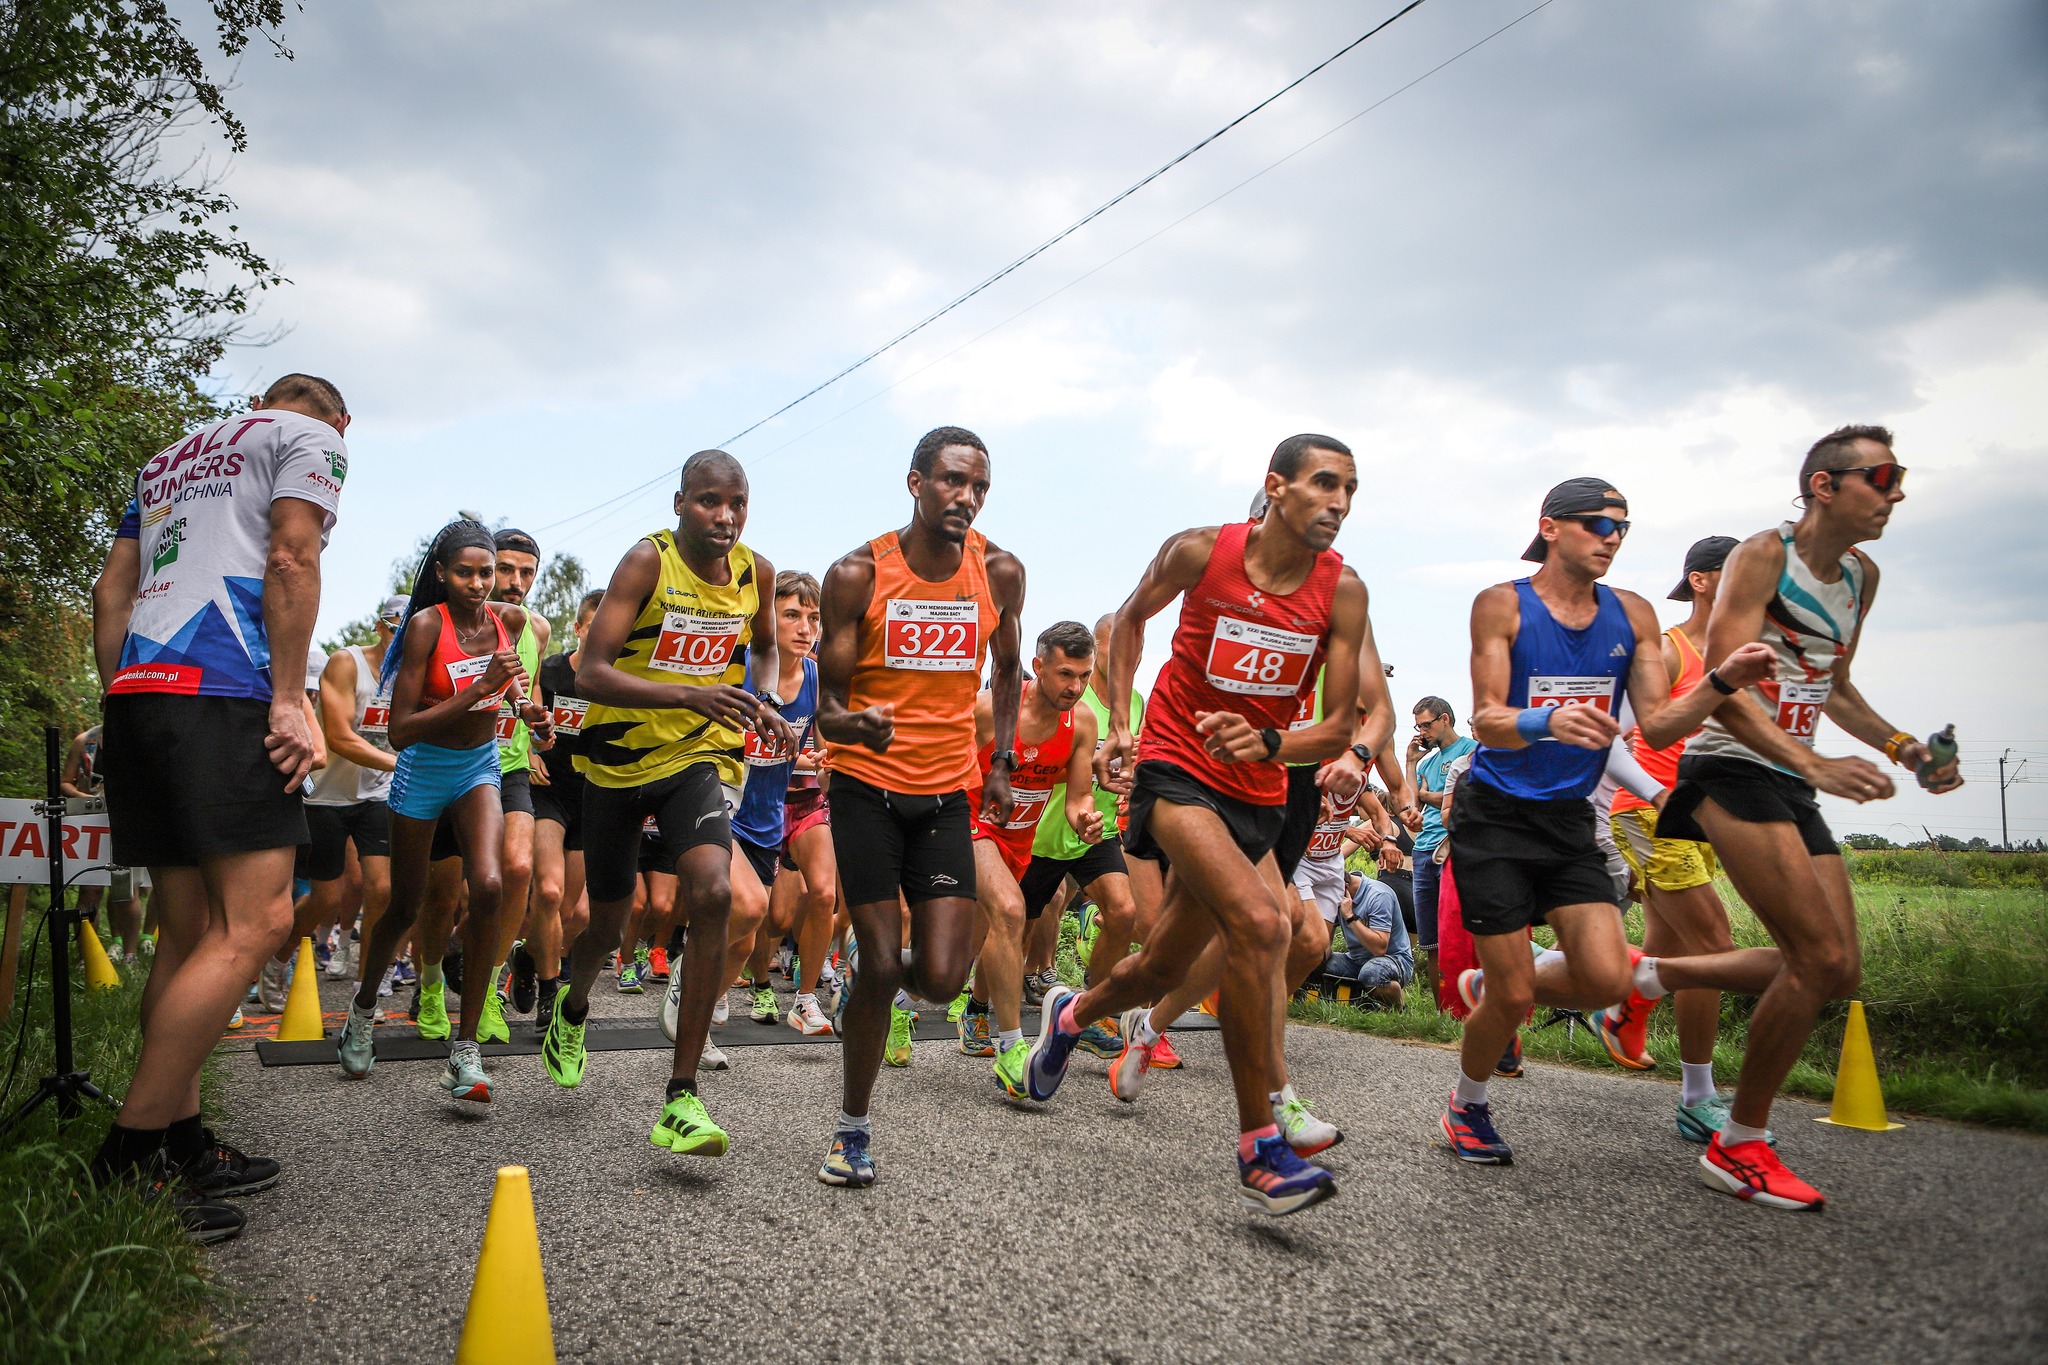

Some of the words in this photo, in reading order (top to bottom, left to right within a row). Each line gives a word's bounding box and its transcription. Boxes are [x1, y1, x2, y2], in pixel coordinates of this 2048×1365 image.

[142, 418, 276, 481] SALT
[668, 635, 728, 664] 106
[899, 623, 967, 656] 322
[1233, 648, 1285, 682] 48
[375, 709, 390, 726] 1
[1311, 831, 1342, 850] 204
